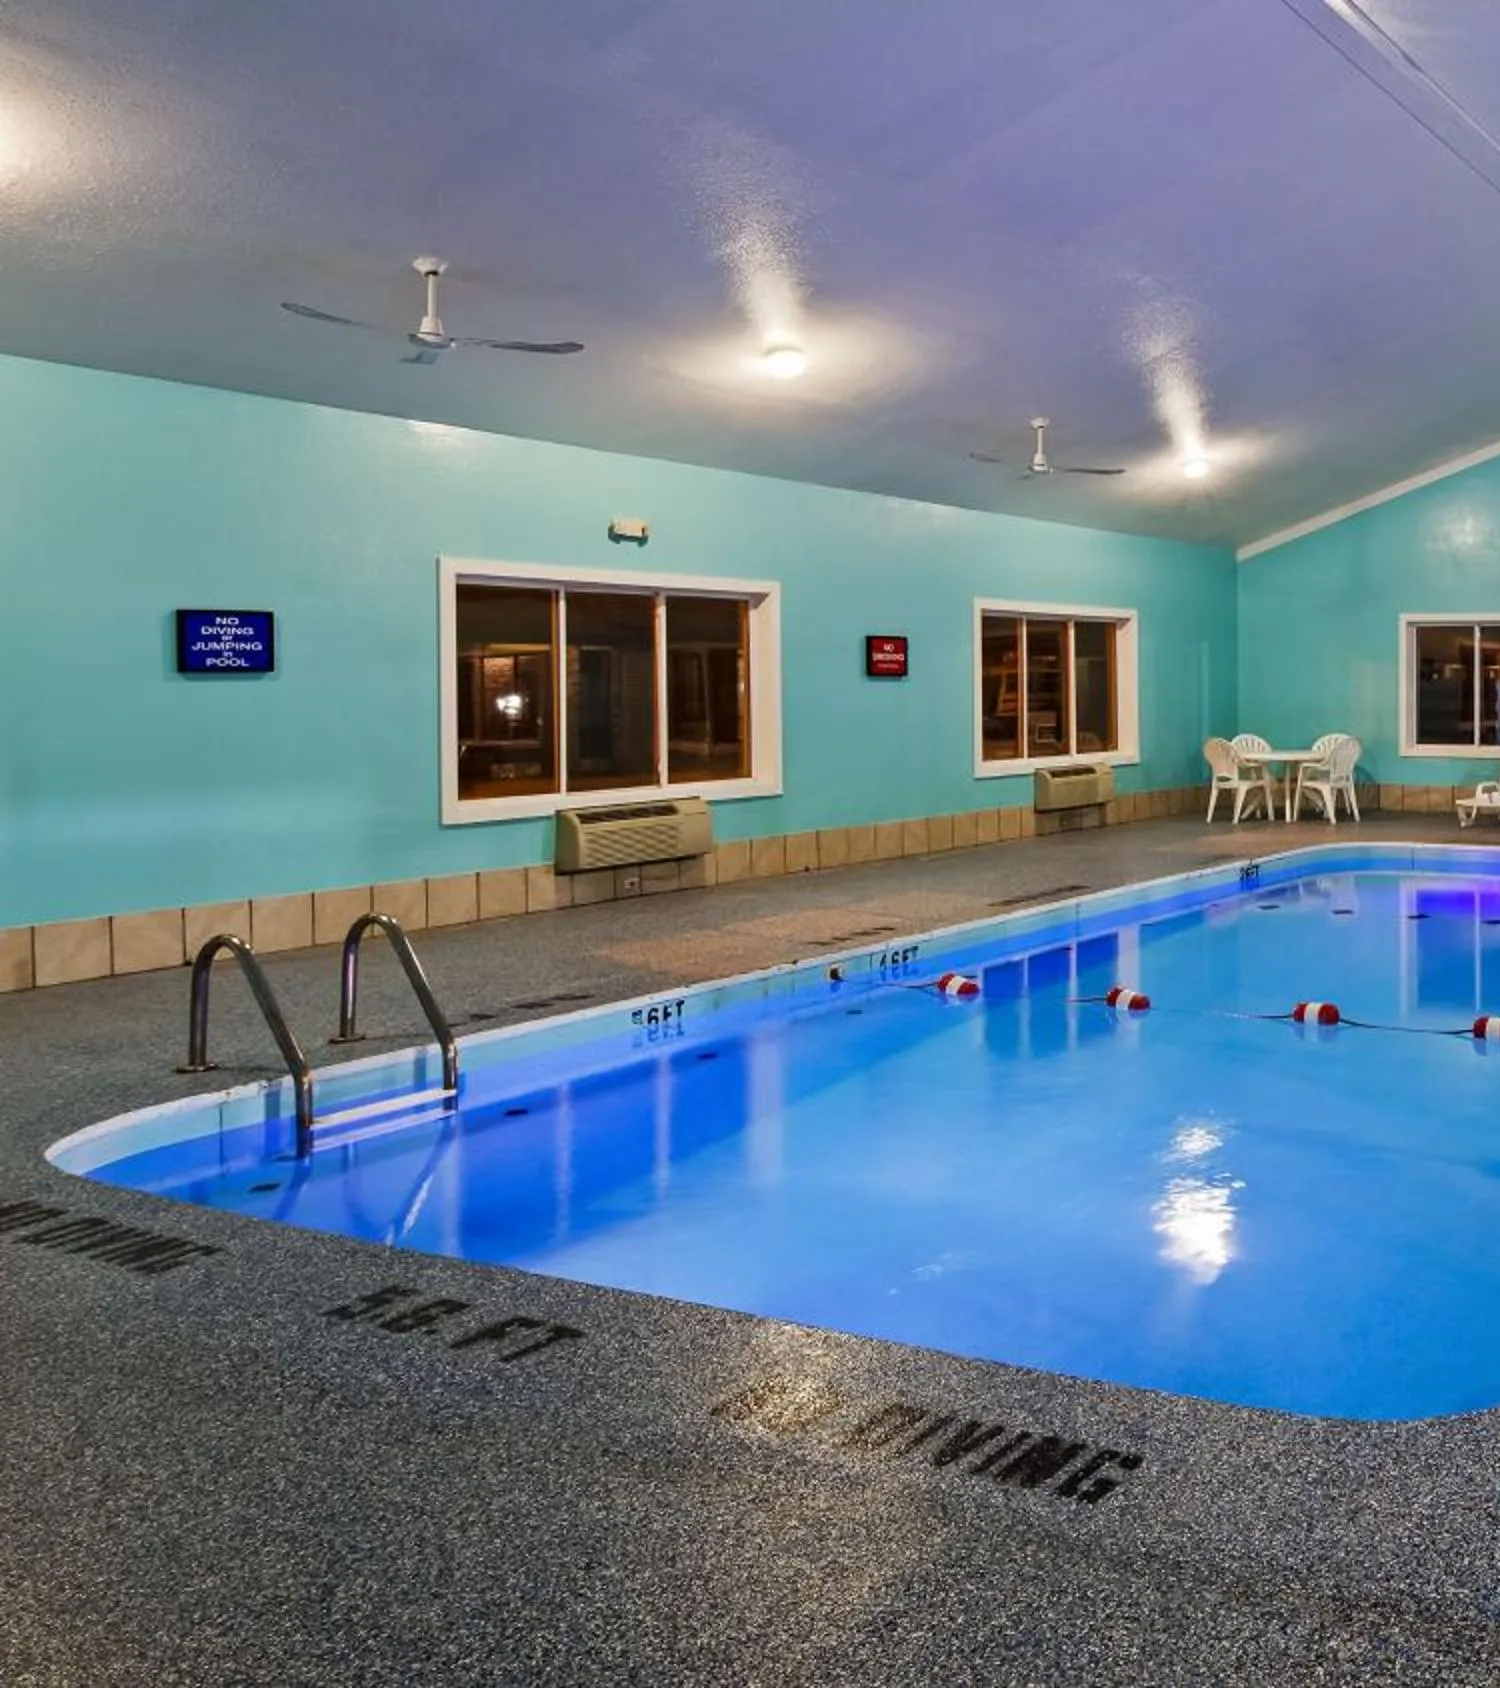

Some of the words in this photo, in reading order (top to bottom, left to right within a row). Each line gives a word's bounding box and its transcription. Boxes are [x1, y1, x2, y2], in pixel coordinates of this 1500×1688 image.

[215, 617, 239, 625] NO
[201, 626, 254, 635] DIVING
[191, 641, 263, 651] JUMPING
[205, 657, 250, 667] POOL
[836, 1402, 1143, 1503] DIVING
